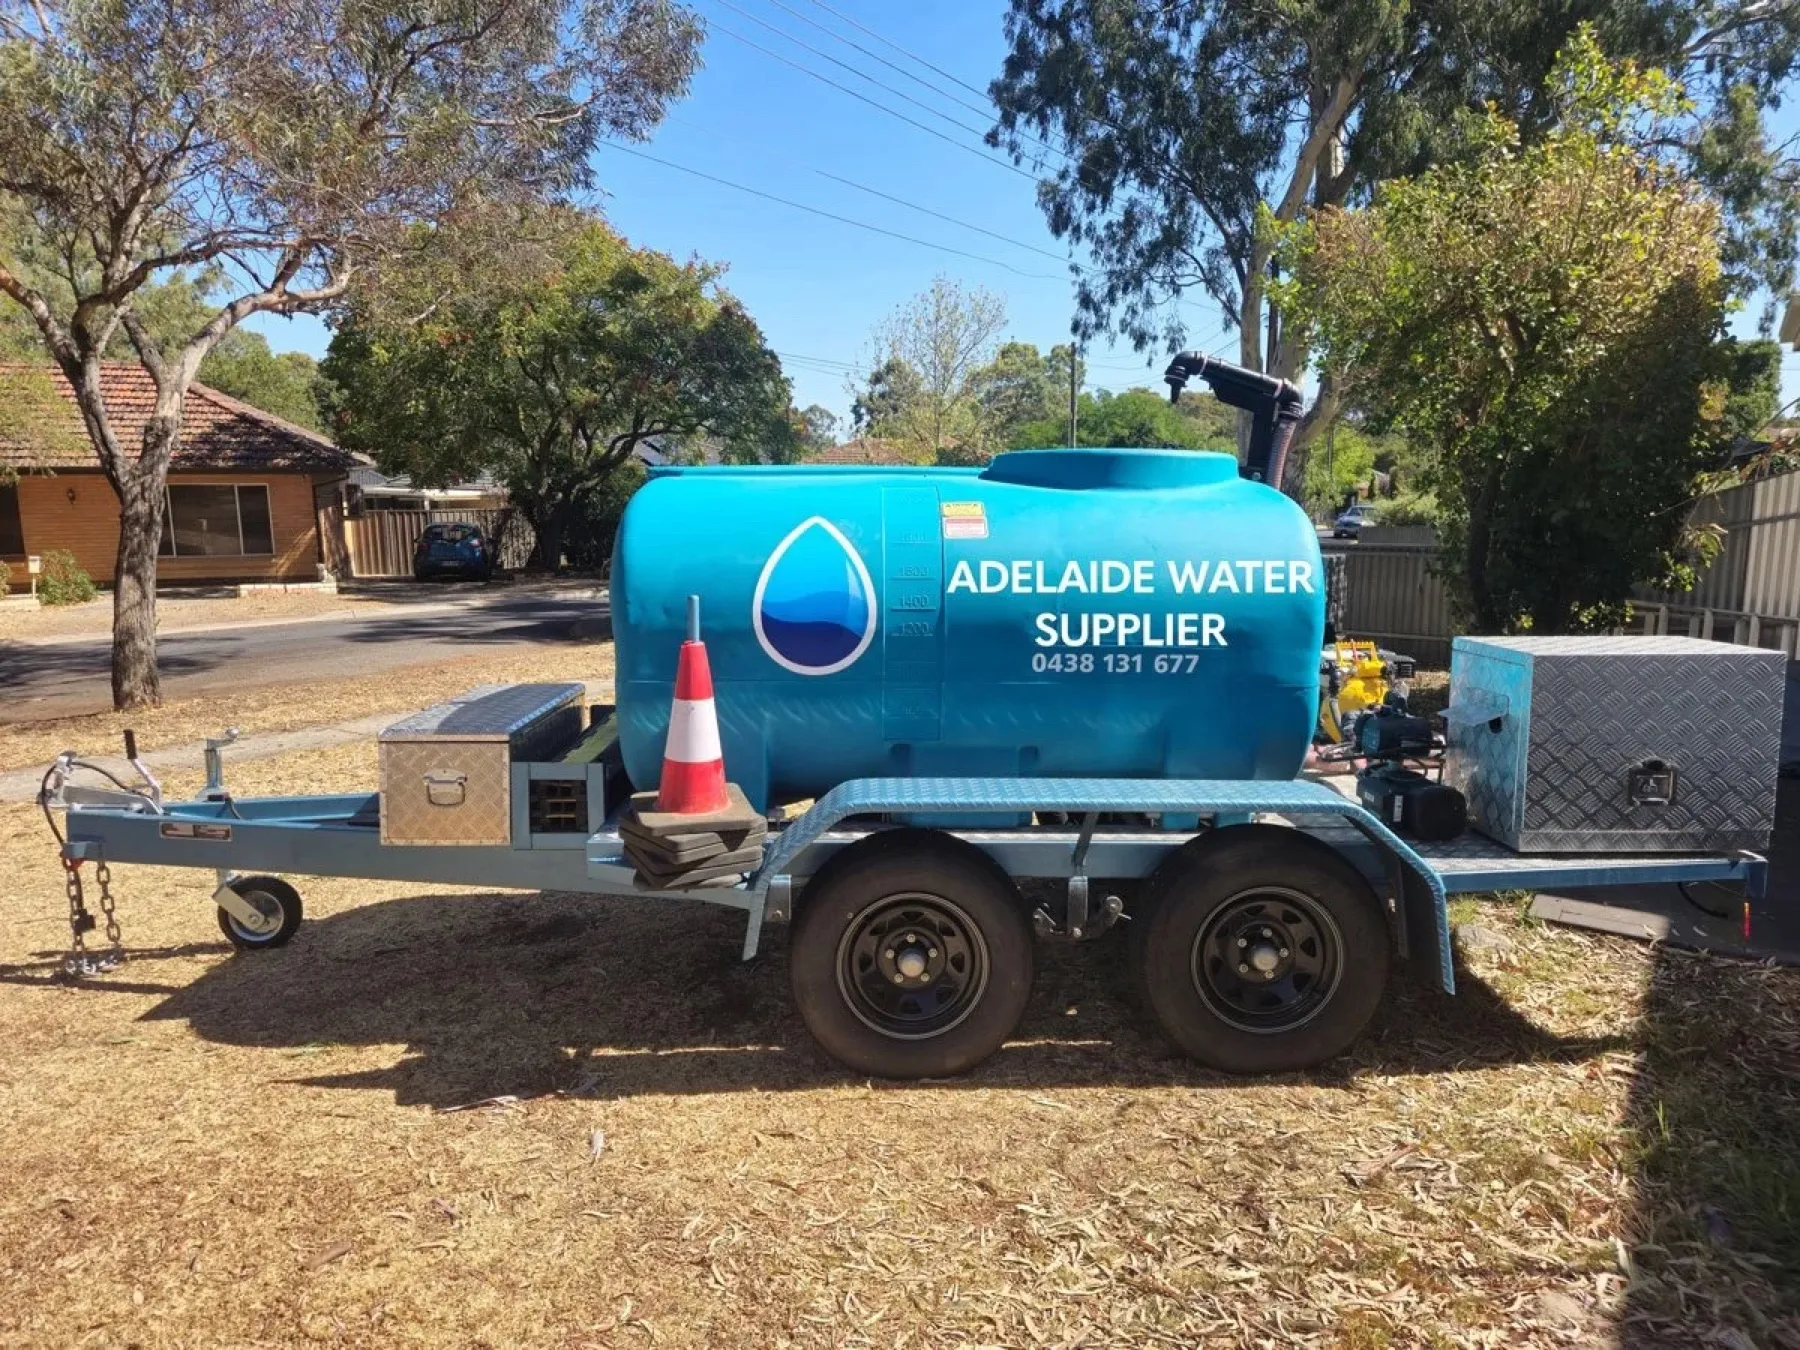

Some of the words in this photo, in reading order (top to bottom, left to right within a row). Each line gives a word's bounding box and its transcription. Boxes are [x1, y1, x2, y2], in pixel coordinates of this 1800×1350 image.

[947, 560, 1154, 594] ADELAIDE
[1167, 560, 1315, 594] WATER
[1034, 612, 1228, 647] SUPPLIER
[1031, 653, 1095, 673] 0438
[1103, 653, 1143, 673] 131
[1154, 653, 1200, 673] 677
